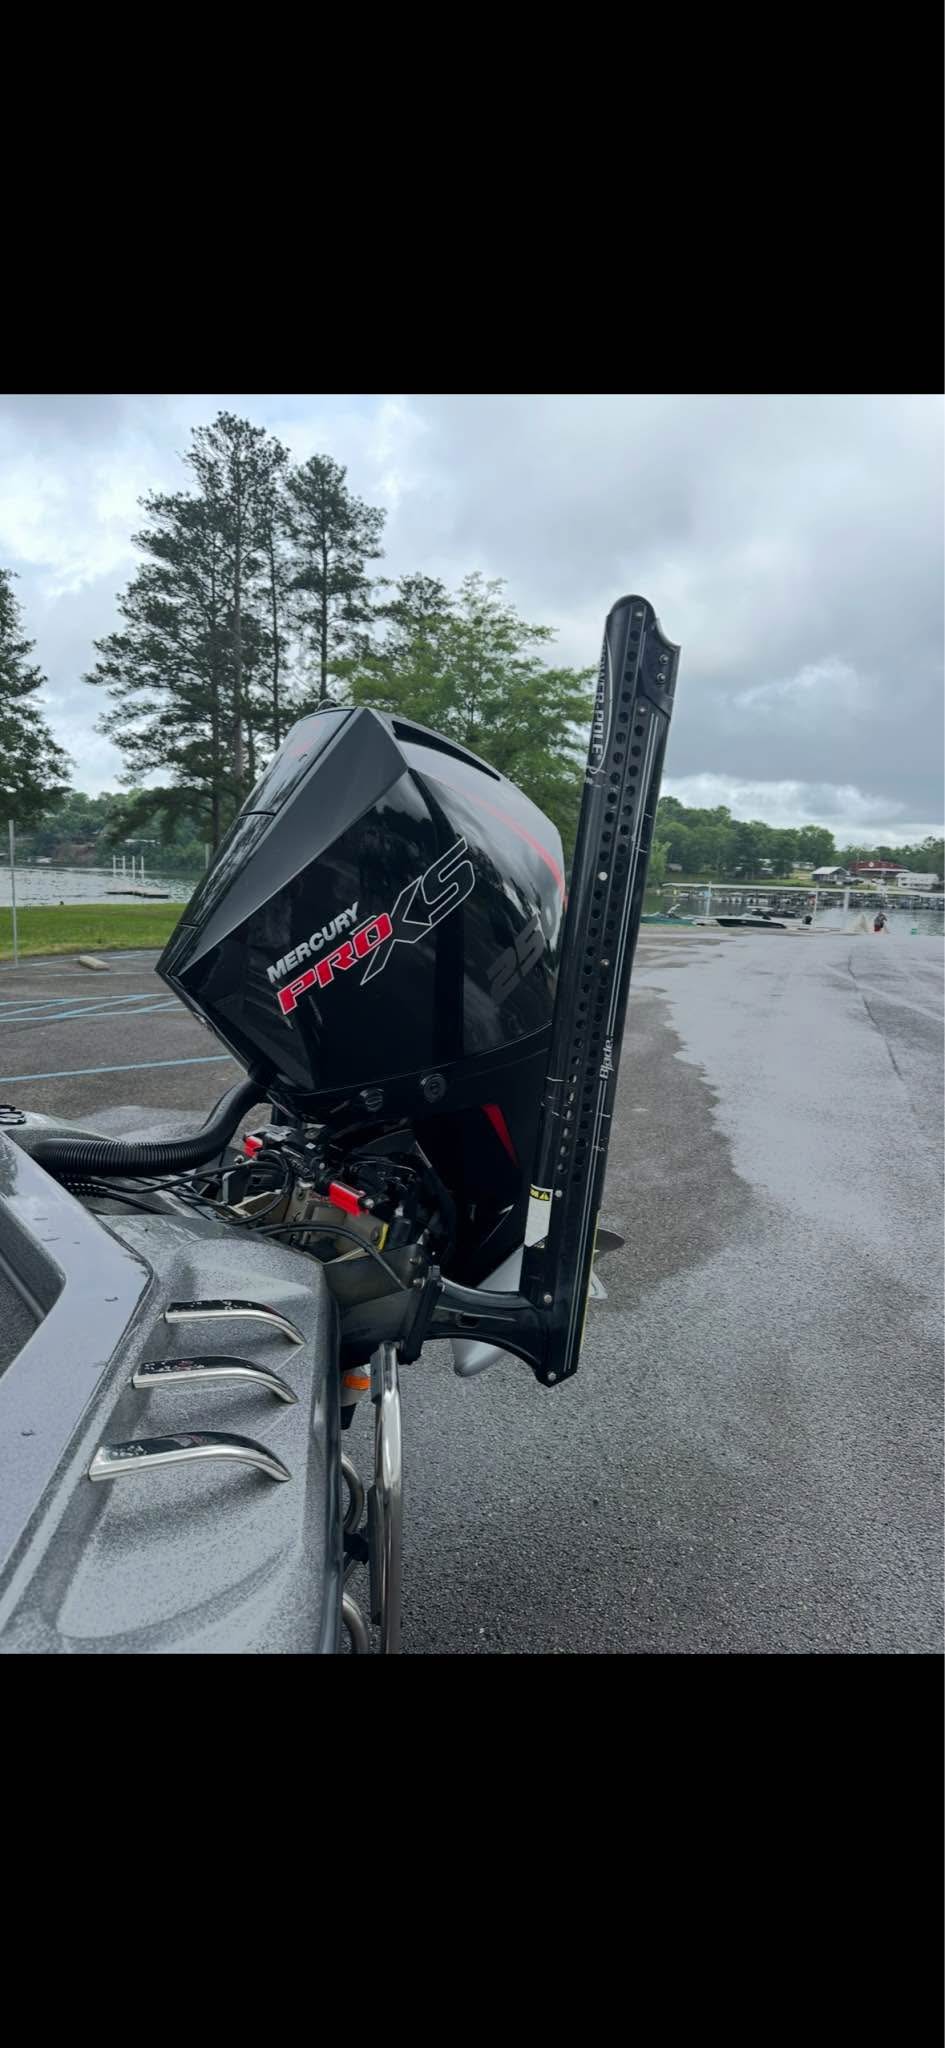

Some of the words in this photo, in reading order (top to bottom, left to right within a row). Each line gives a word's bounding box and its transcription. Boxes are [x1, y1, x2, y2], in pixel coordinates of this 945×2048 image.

[266, 901, 360, 983] MERCURY
[277, 912, 393, 1015] PRO
[351, 837, 475, 985] XS
[599, 1039, 614, 1079] Blade
